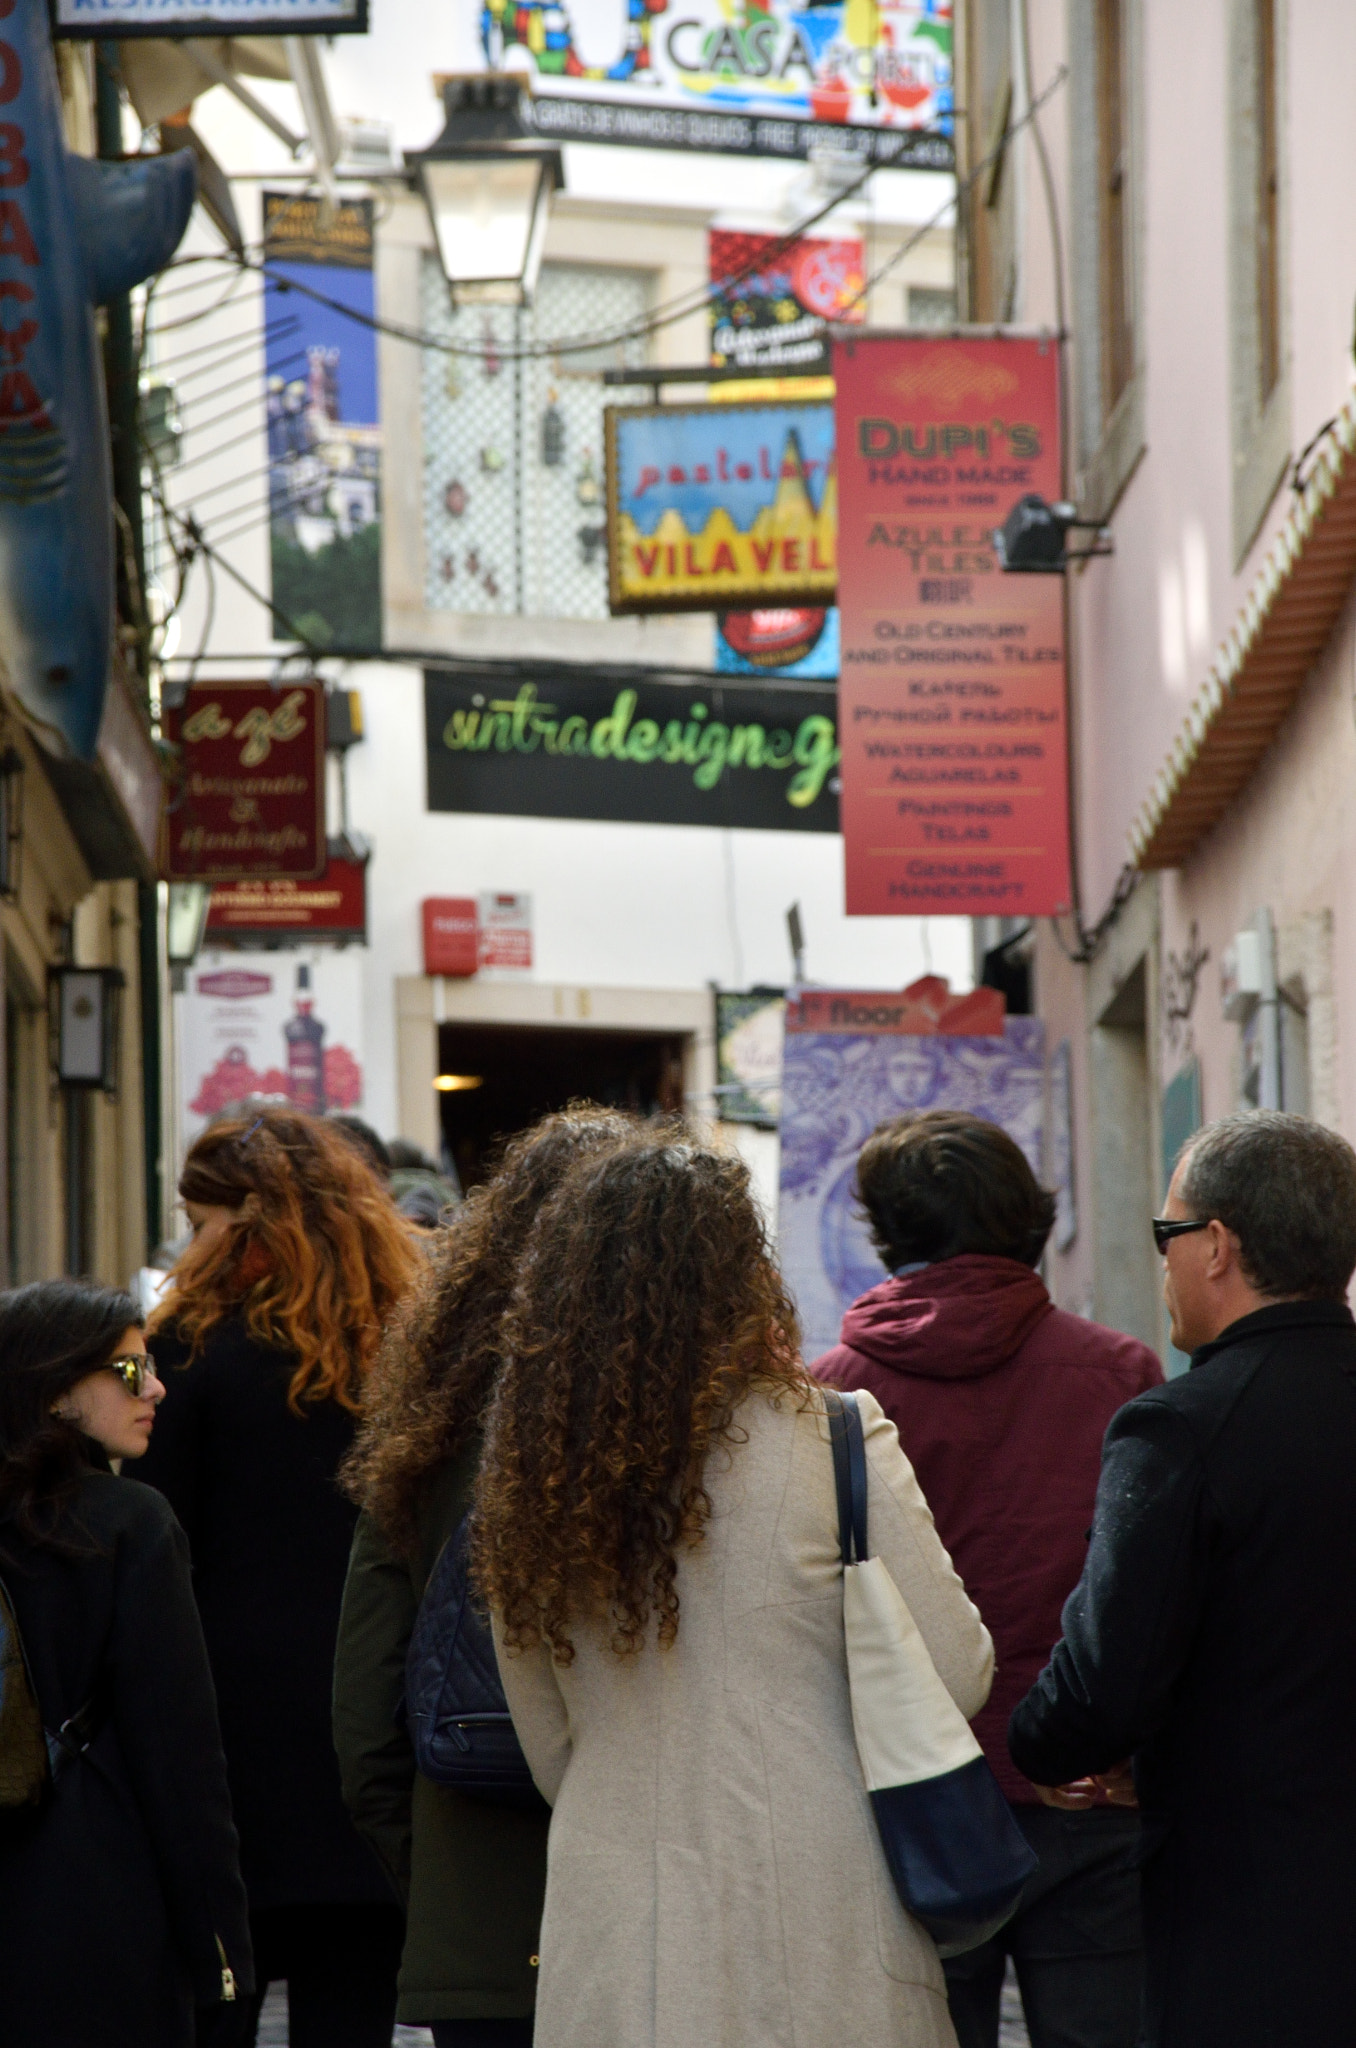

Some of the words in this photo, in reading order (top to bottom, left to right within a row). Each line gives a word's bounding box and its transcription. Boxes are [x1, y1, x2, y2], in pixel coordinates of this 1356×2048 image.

[666, 19, 814, 87] CASA
[634, 540, 738, 579] VILA
[751, 535, 832, 573] VEL
[831, 998, 905, 1026] floor
